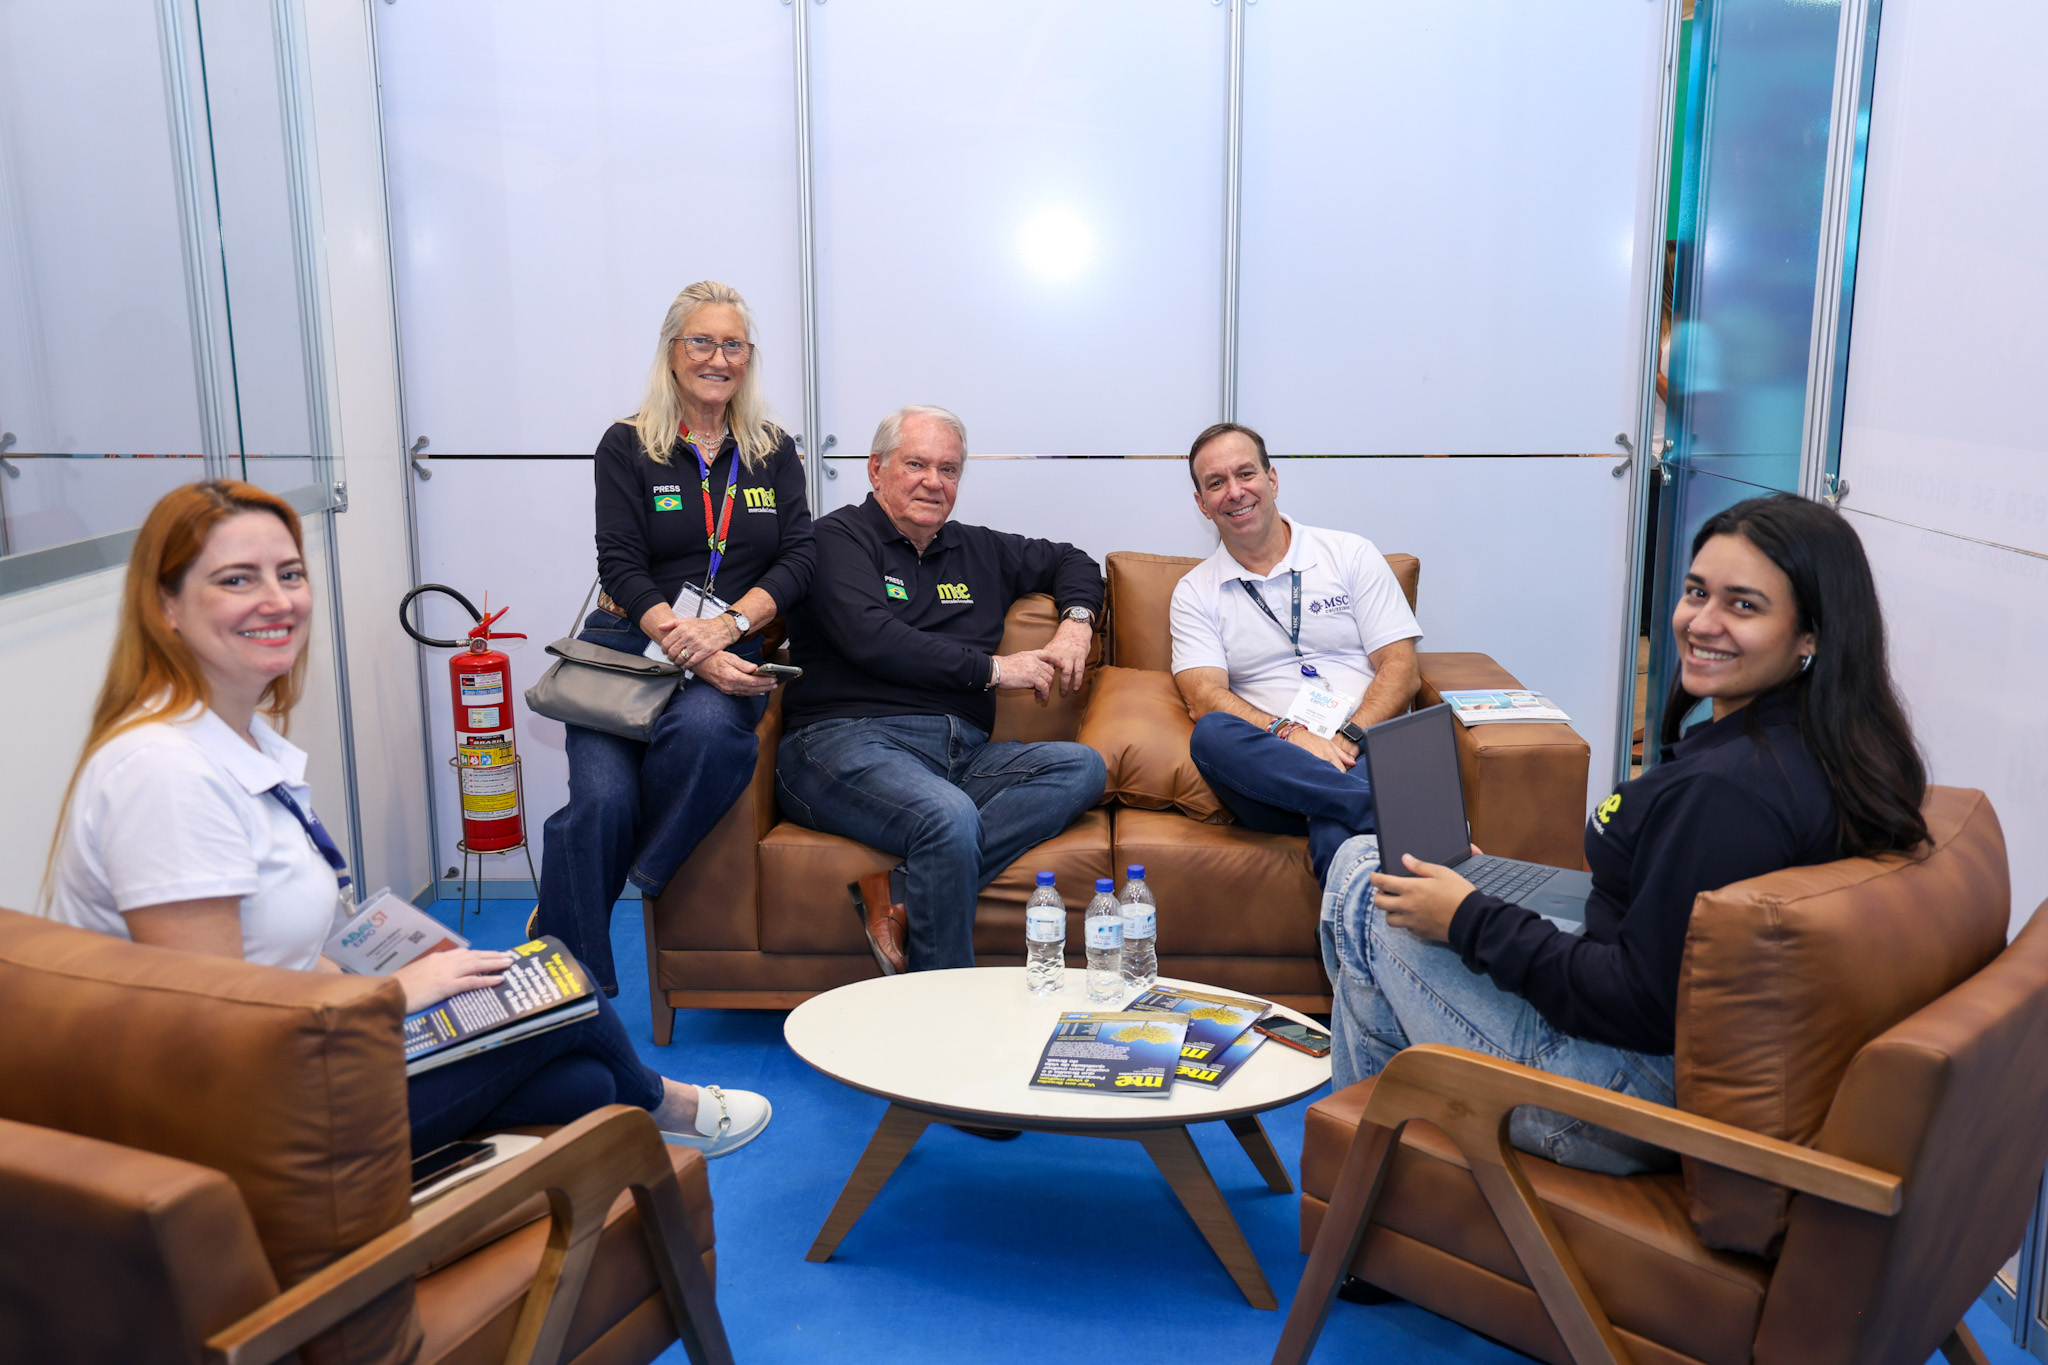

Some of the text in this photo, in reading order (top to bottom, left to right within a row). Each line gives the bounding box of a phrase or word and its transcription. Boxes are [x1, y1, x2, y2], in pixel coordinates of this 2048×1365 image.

[653, 485, 681, 493] PRESS
[884, 575, 905, 586] PRESS
[1323, 595, 1349, 609] MSC
